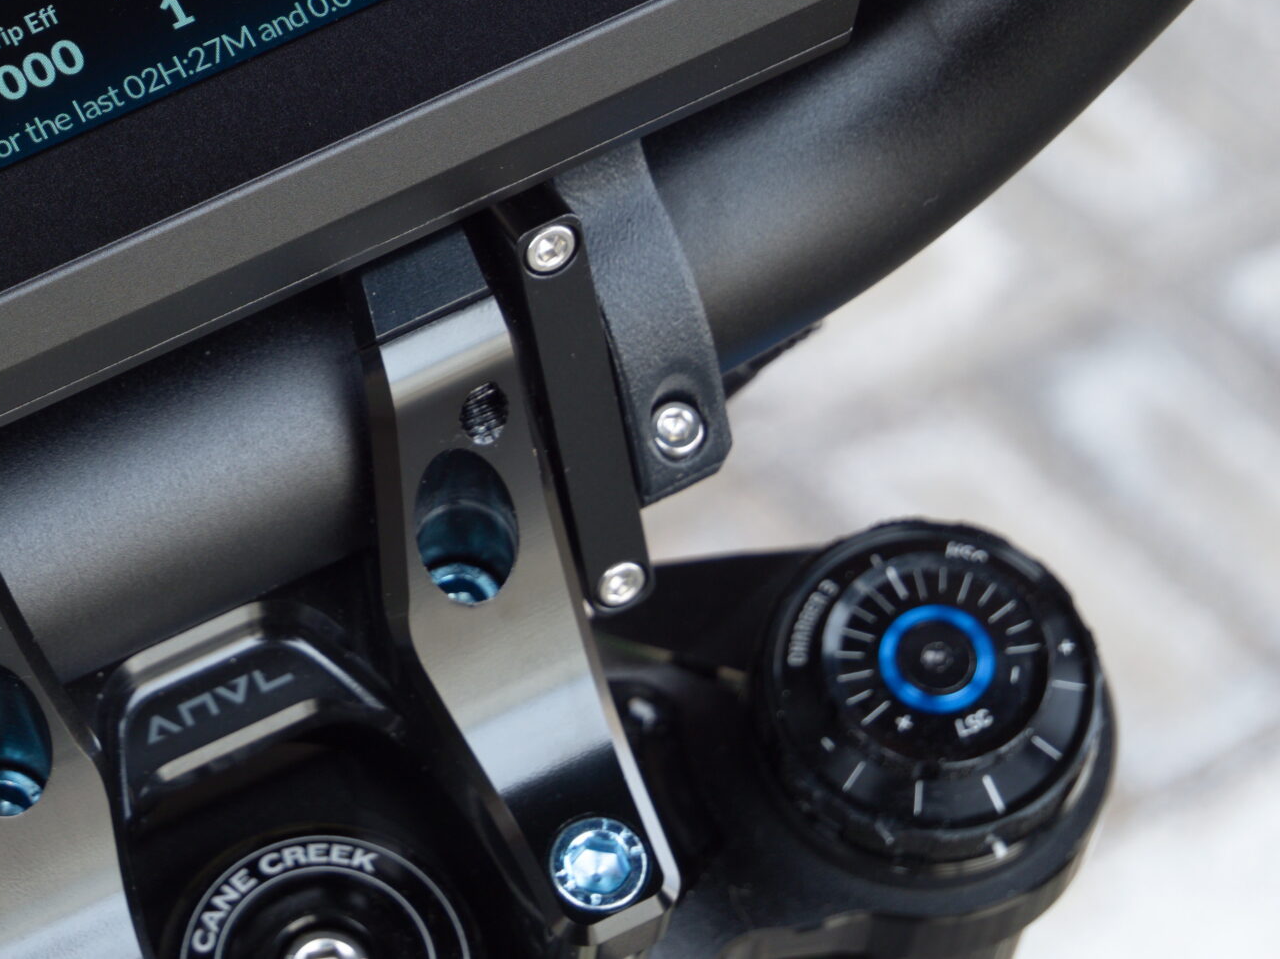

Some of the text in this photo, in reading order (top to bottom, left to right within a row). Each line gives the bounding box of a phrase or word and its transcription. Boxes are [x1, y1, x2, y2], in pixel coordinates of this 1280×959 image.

[23, 5, 61, 35] Eff
[25, 107, 73, 141] the
[72, 86, 125, 126] last
[123, 25, 258, 100] 02H:27M
[259, 4, 310, 43] and
[954, 708, 994, 738] LSC
[191, 842, 379, 953] CANE CREEK
